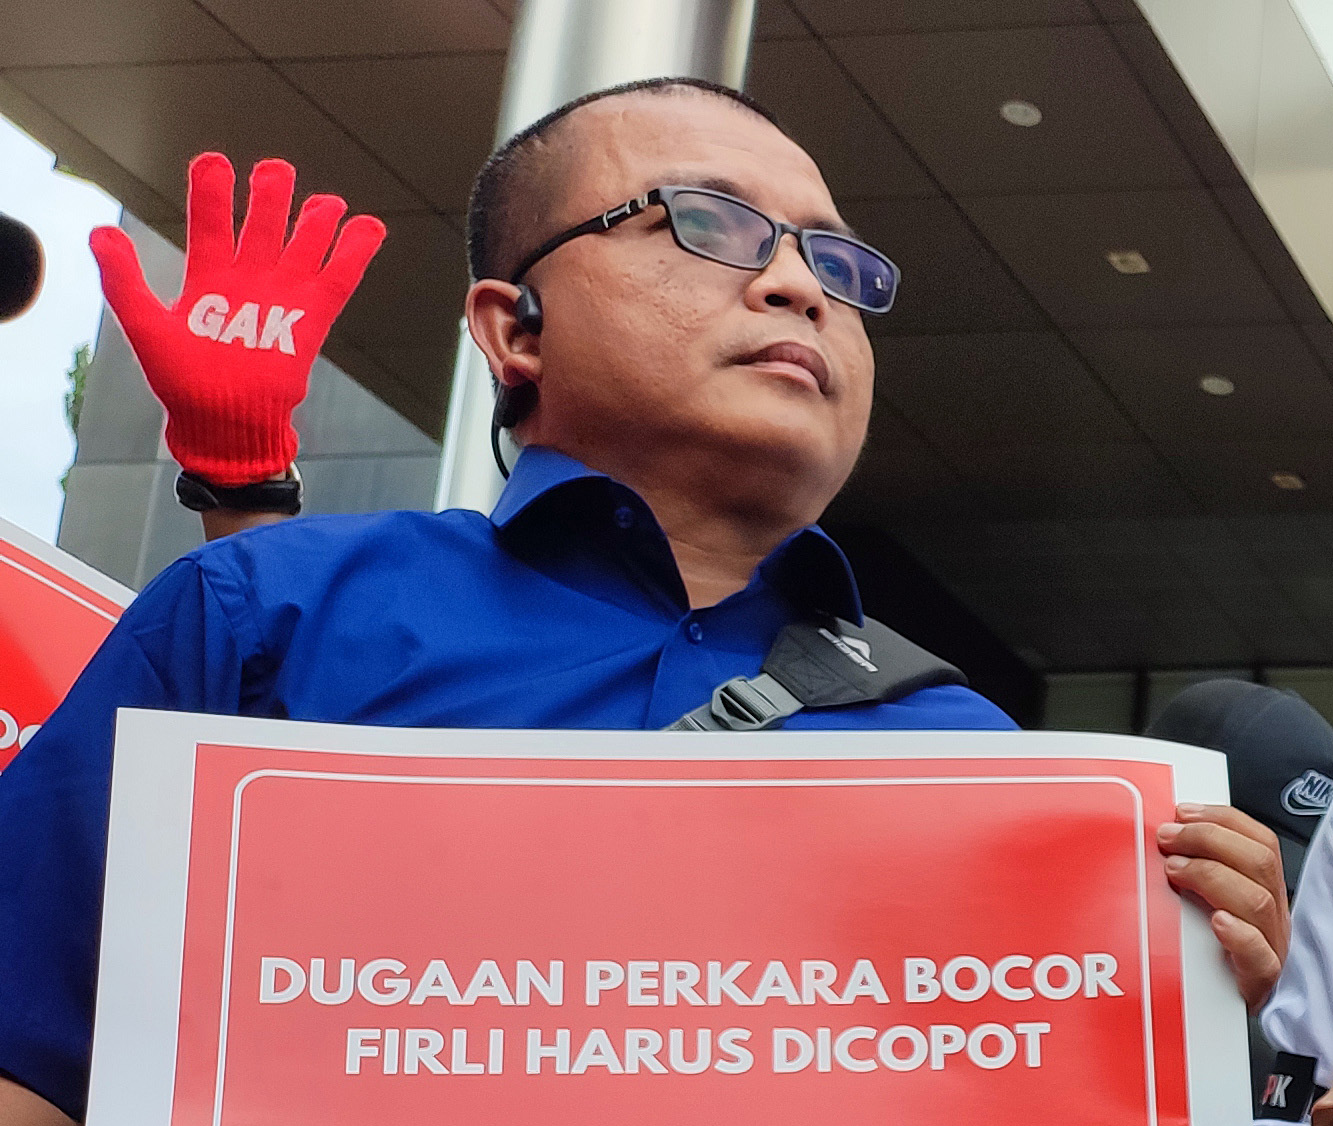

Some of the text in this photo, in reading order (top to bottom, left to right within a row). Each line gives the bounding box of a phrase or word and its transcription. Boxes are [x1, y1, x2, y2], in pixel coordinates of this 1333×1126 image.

[187, 292, 306, 357] GAK
[258, 952, 1125, 1007] DUGAAN PERKARA BOCOR
[345, 1022, 1052, 1075] FIRLI HARUS DICOPOT
